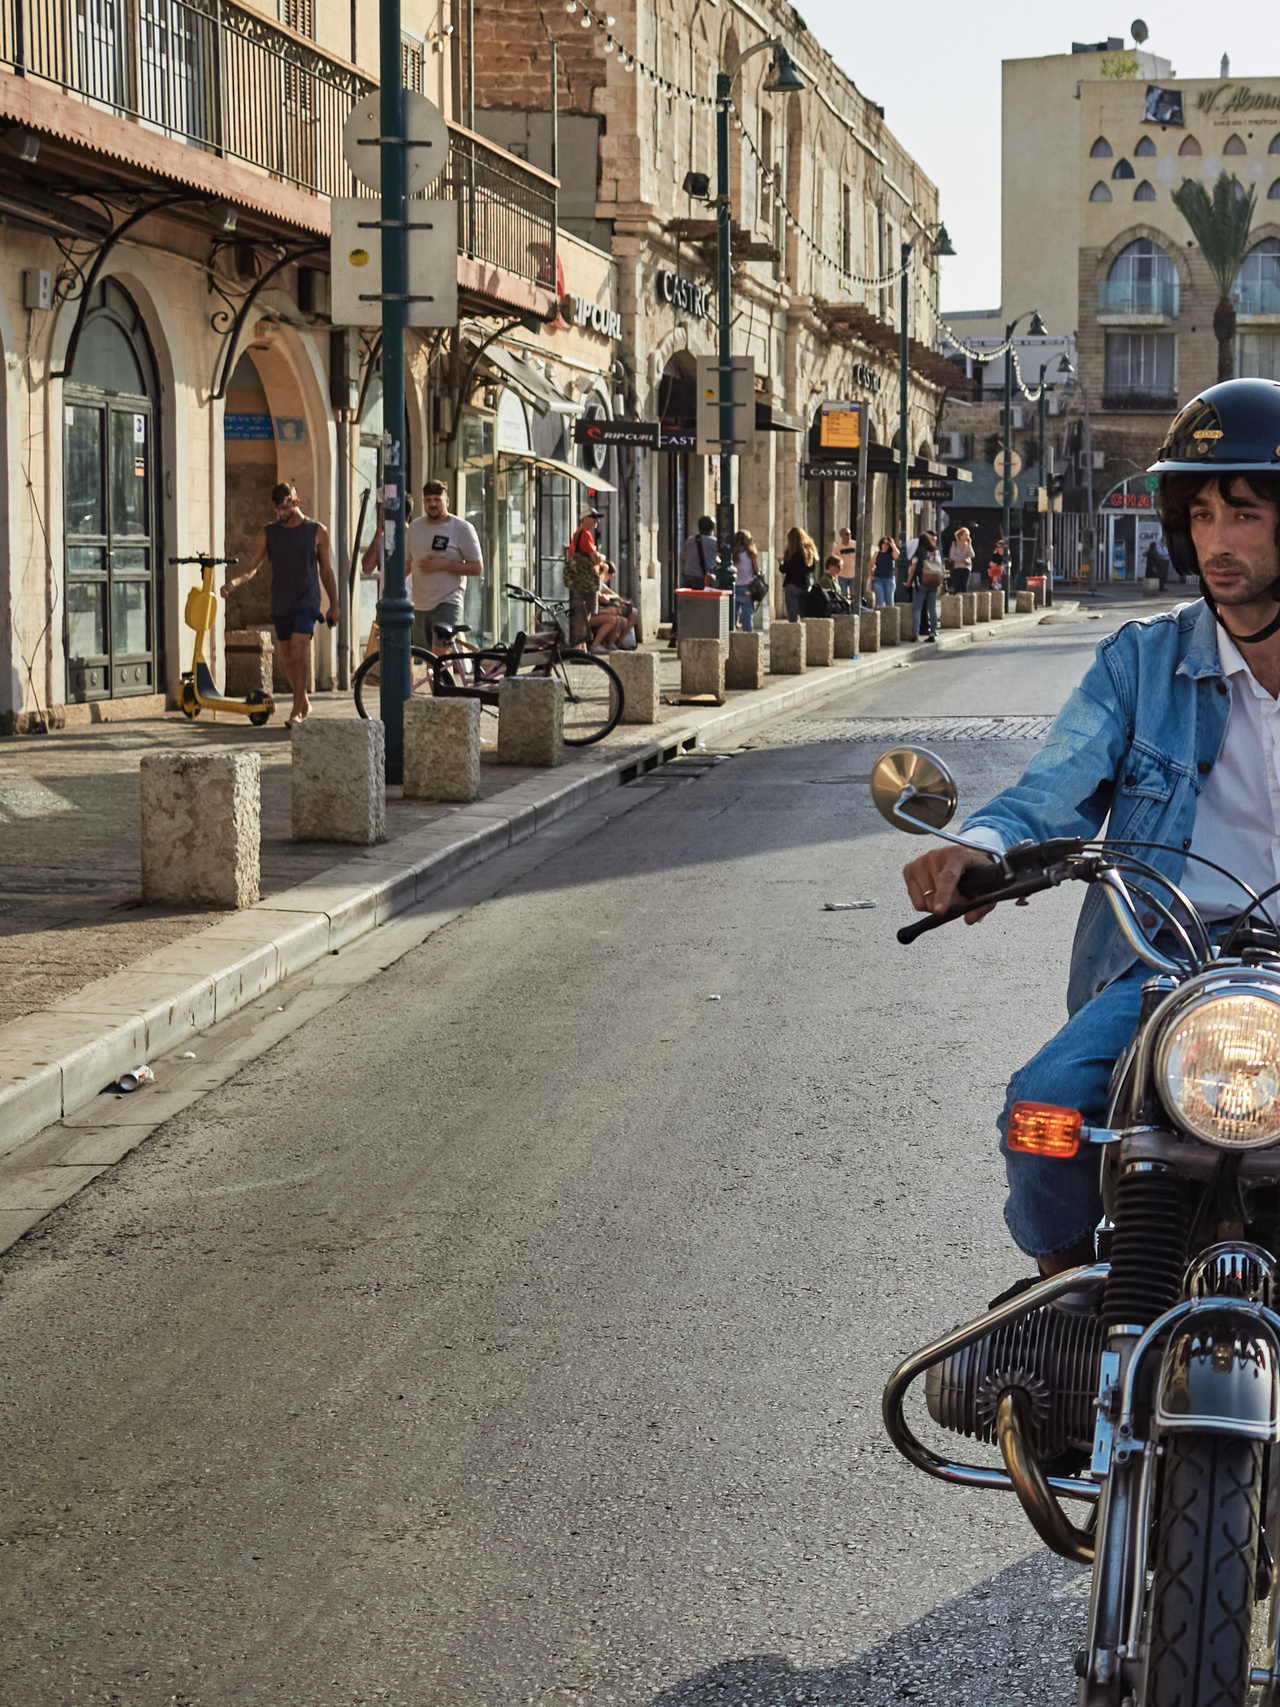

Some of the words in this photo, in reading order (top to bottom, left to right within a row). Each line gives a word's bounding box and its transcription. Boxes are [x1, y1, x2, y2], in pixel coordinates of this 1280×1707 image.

[591, 304, 622, 341] CURL
[604, 432, 622, 440] RIP
[625, 433, 655, 441] CURL
[660, 436, 697, 446] CAST
[810, 468, 857, 477] CASTRO
[913, 490, 950, 498] CASTRO
[1111, 493, 1150, 507] CHA
